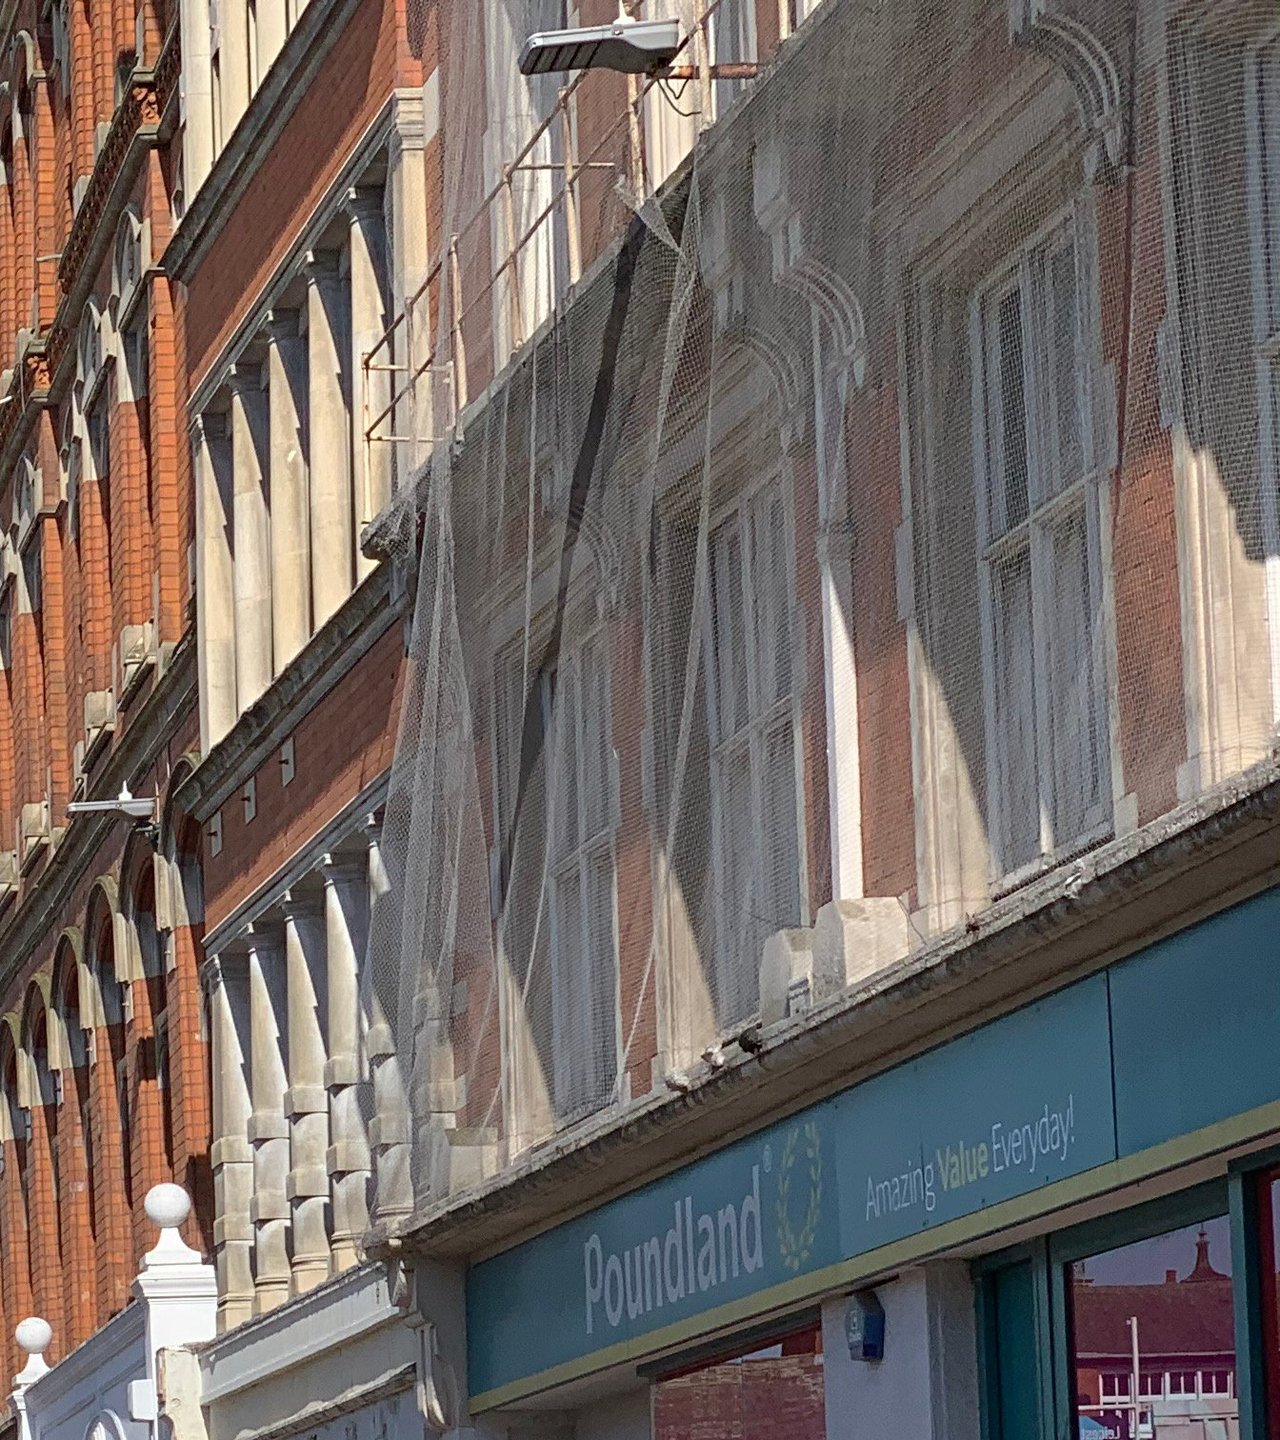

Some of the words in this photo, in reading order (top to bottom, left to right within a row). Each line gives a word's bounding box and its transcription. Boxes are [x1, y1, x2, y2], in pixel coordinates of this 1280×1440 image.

[866, 1160, 936, 1222] Amazing
[937, 1140, 989, 1191] Value
[992, 1094, 1075, 1173] Everyday!
[584, 1164, 764, 1335] Poundland
